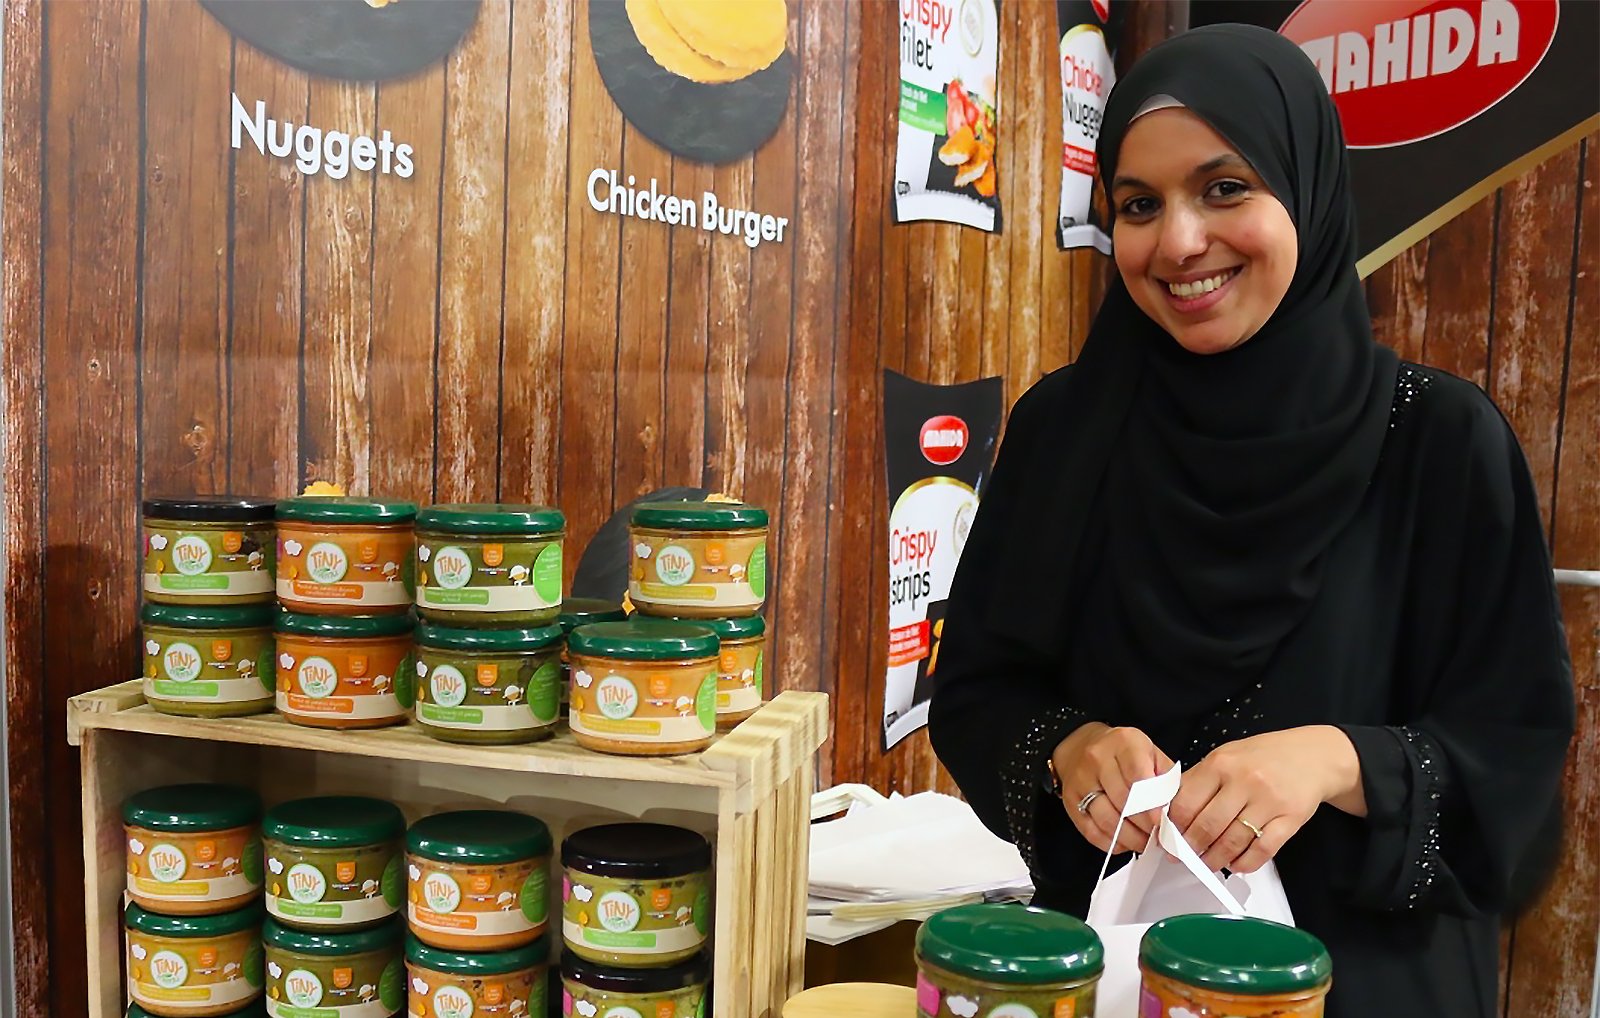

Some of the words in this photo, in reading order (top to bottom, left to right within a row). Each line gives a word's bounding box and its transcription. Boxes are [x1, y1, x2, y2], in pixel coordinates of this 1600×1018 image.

[901, 21, 934, 71] filet
[231, 92, 414, 180] Nuggets
[586, 168, 697, 228] Chicken
[702, 191, 789, 248] Burger
[891, 527, 938, 569] Crispy
[891, 568, 931, 610] strips
